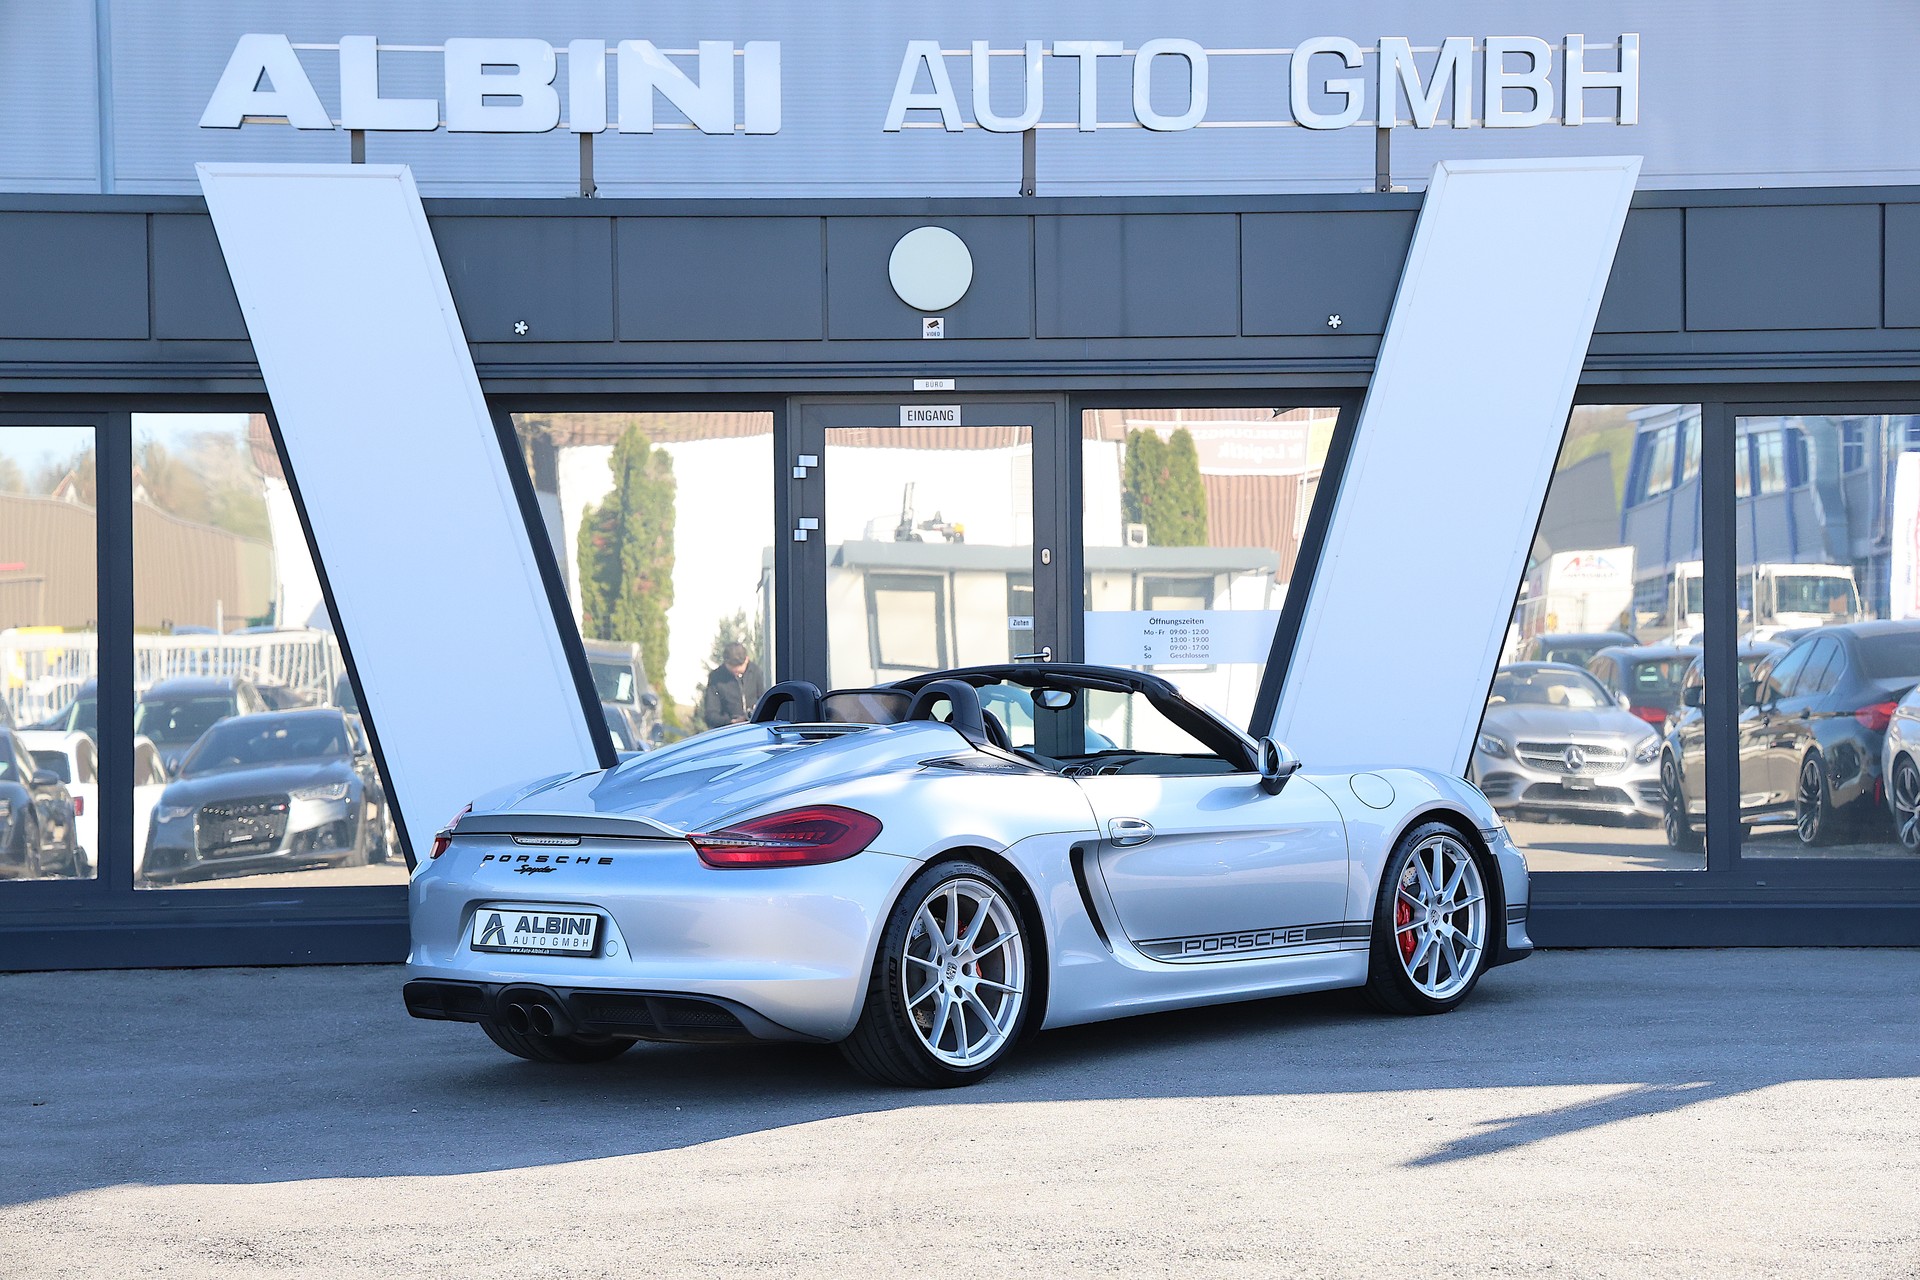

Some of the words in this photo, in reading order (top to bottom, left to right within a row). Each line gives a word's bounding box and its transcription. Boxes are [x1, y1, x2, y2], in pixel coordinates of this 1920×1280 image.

[199, 33, 781, 135] ALBINI
[883, 38, 1209, 133] AUTO
[1289, 32, 1641, 131] GMBH
[907, 410, 954, 421] EINGANG
[1149, 617, 1204, 626] Öffnungszeiten
[482, 854, 614, 865] PORSCHE
[514, 864, 557, 876] Spyder
[515, 916, 591, 935] ALBINI
[513, 935, 546, 946] AUTO
[552, 937, 589, 948] GMBH
[1184, 929, 1304, 954] PORSCHE
